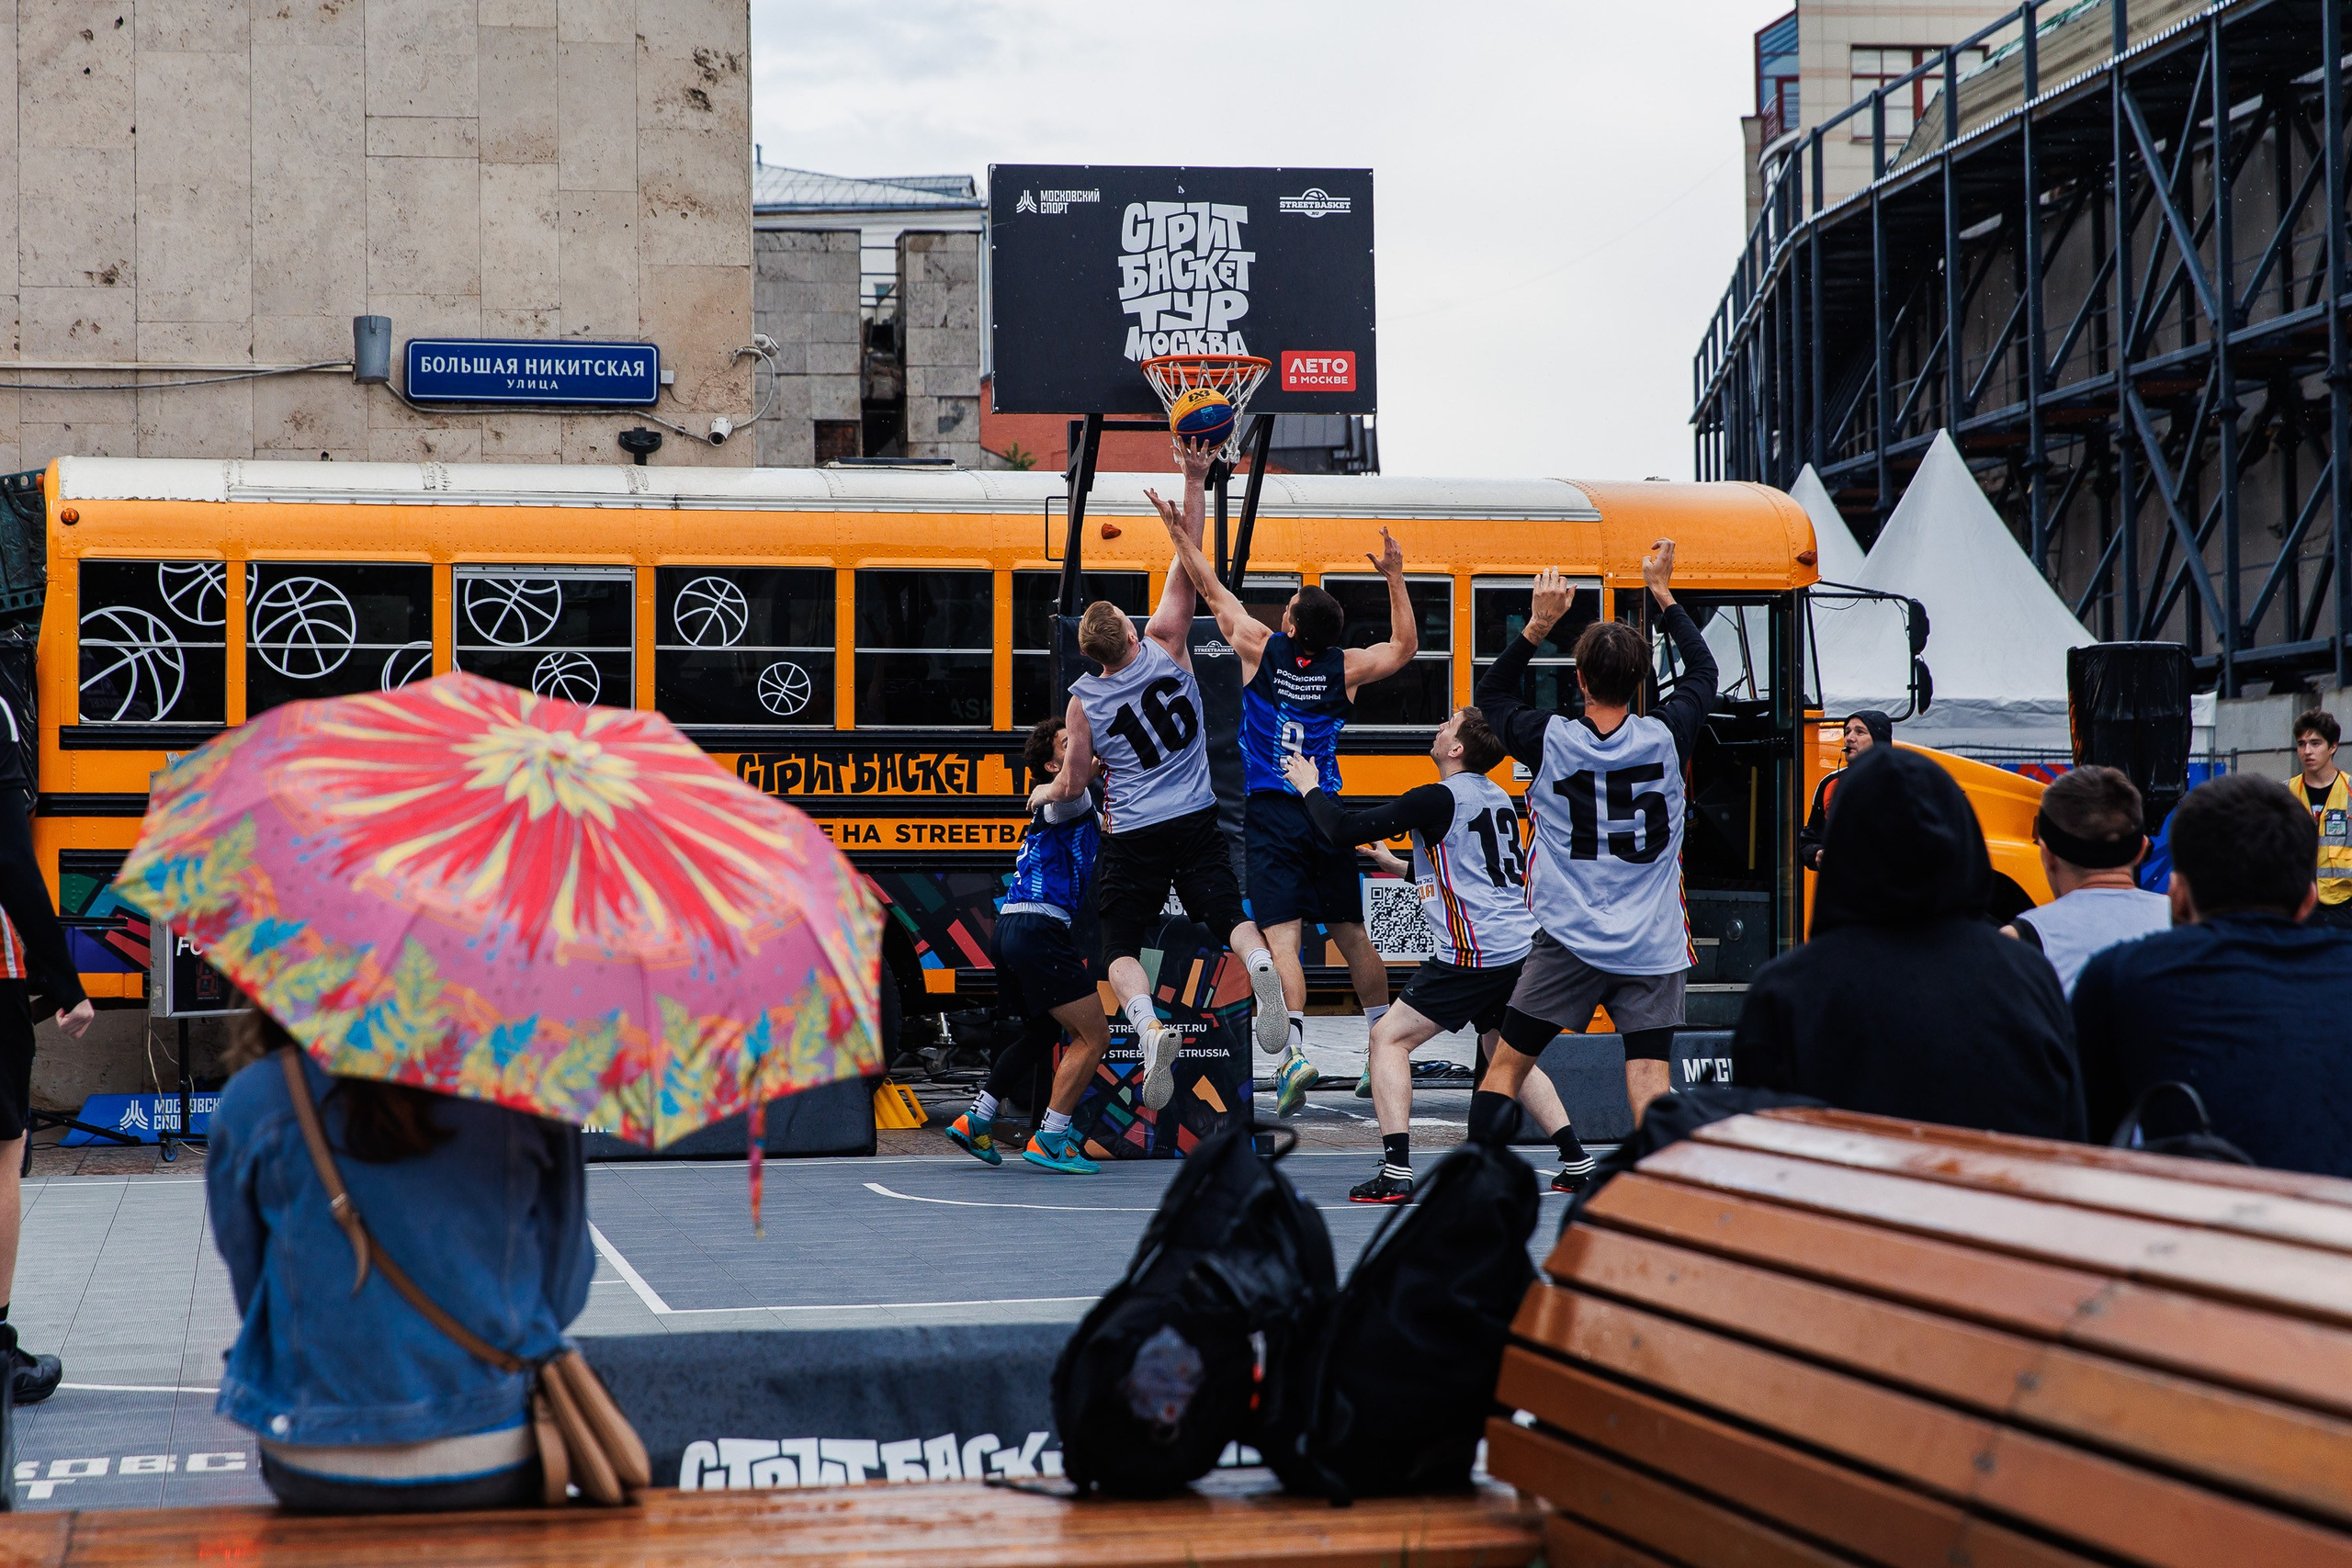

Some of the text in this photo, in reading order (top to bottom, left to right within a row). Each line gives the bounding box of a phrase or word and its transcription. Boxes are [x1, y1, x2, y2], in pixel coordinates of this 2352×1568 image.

[1040, 188, 1100, 202] МОСКОВСКИЙ
[1040, 202, 1069, 214] СПОРТ
[1279, 200, 1351, 209] STREETBASKET
[1121, 200, 1249, 257] СТРИТ
[1117, 249, 1256, 300] БАСКЕТ
[1121, 290, 1250, 332] ТУР
[1124, 326, 1250, 362] МОСКВА
[421, 355, 645, 378] БОЛЬШАЯ НИКИТСКАЯ
[1289, 357, 1349, 374] ЛЕТО
[506, 378, 559, 390] УЛИЦА
[1289, 376, 1349, 384] В МОСКВЕ
[1276, 668, 1327, 682] РОССИЙСКИЙ
[1272, 677, 1328, 692] УНИВЕРСИТЕТ
[1277, 688, 1321, 701] МЕДИЦИНЫ
[1106, 677, 1198, 771] 16
[1279, 721, 1306, 773] 9
[737, 753, 850, 795] СТРИТ
[850, 753, 986, 795] БАСКЕТ
[1553, 761, 1670, 864] 15
[843, 825, 881, 843] НА
[1468, 807, 1526, 887] 13
[1108, 1023, 1207, 1033] STRESKET.RU
[1109, 1049, 1230, 1058] STREEETRUSSIA
[154, 1098, 224, 1114] МОСОВСК
